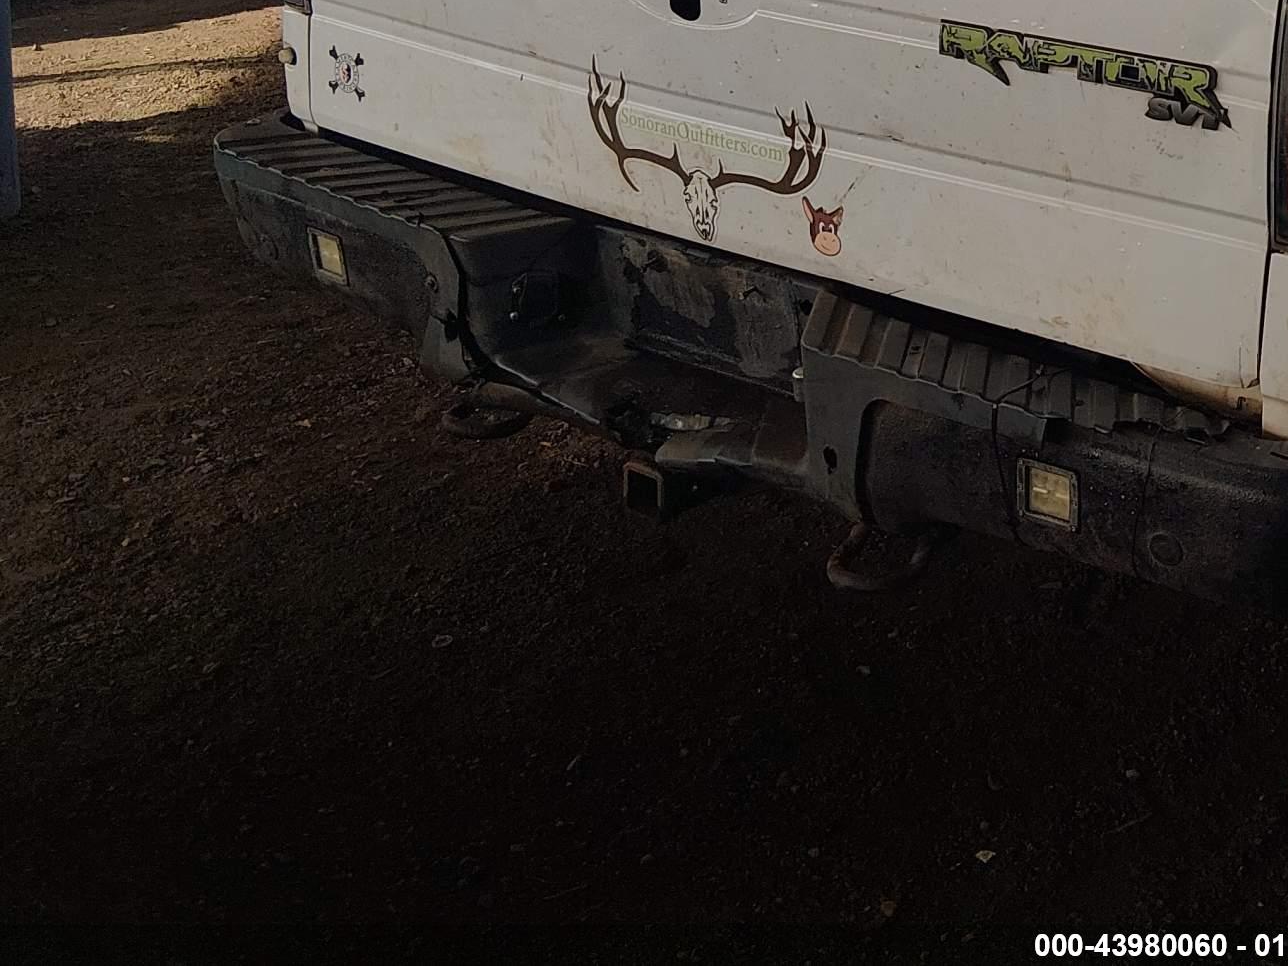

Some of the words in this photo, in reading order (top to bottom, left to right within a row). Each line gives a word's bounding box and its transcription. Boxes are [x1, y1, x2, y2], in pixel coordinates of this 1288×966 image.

[939, 19, 1230, 124] RAPTOR
[619, 106, 783, 162] SonoranOutfitters.com
[1145, 96, 1222, 131] SVT
